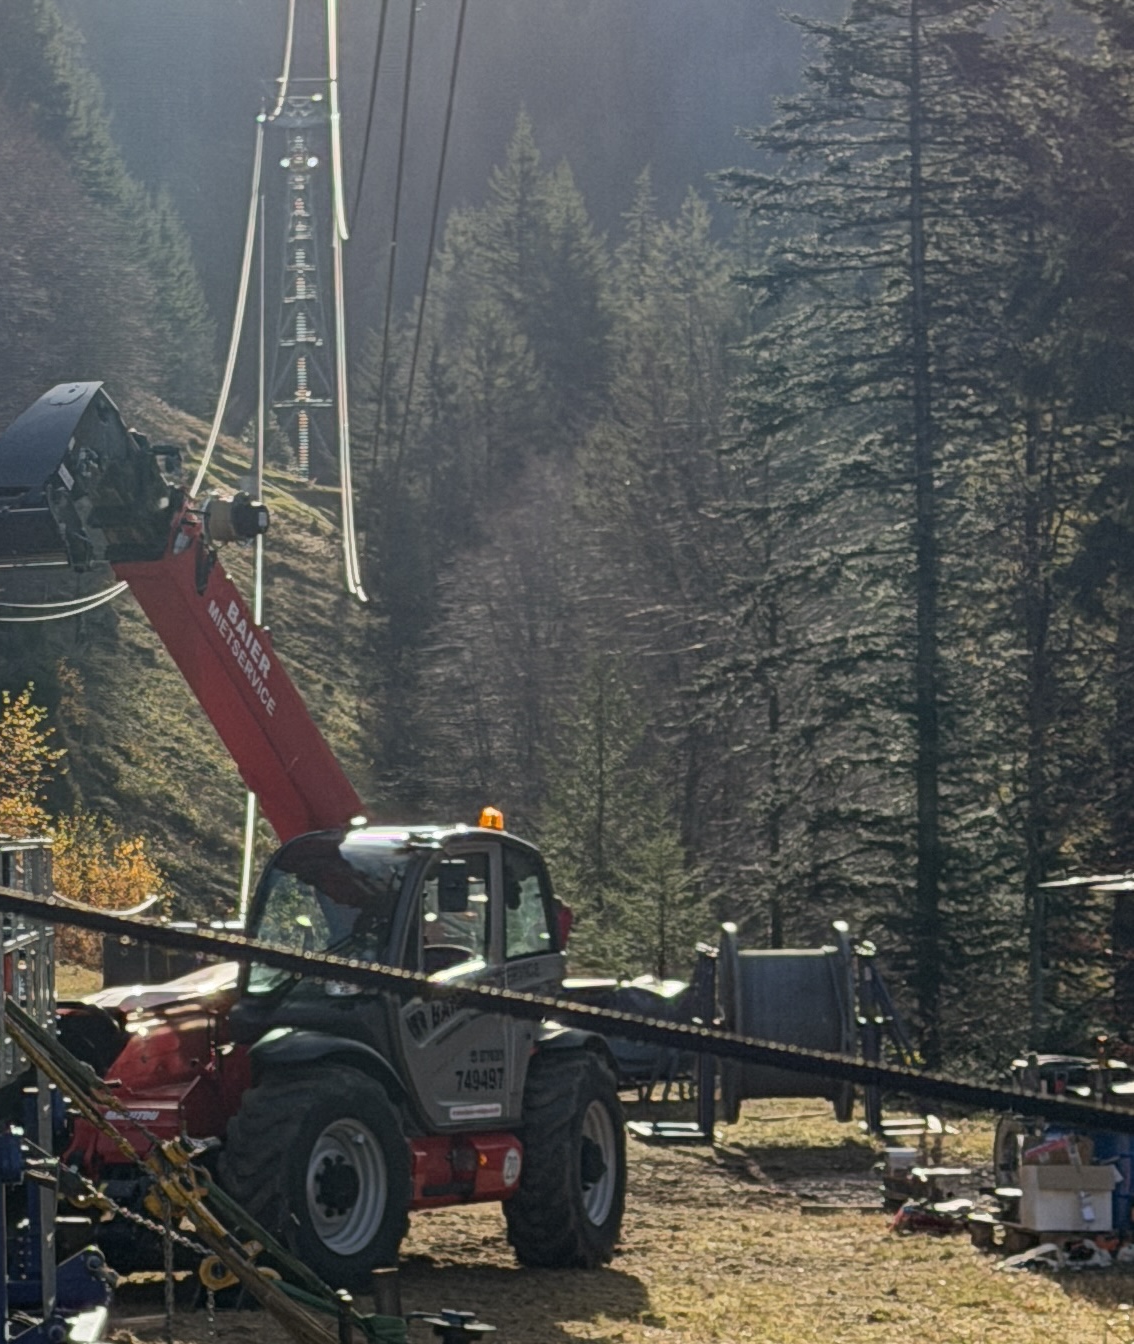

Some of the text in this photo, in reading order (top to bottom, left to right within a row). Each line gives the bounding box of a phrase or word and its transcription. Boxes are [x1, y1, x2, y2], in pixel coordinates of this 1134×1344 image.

[208, 599, 276, 717] MIETSERVICE
[227, 600, 271, 679] BAIER
[456, 1067, 505, 1093] 749497
